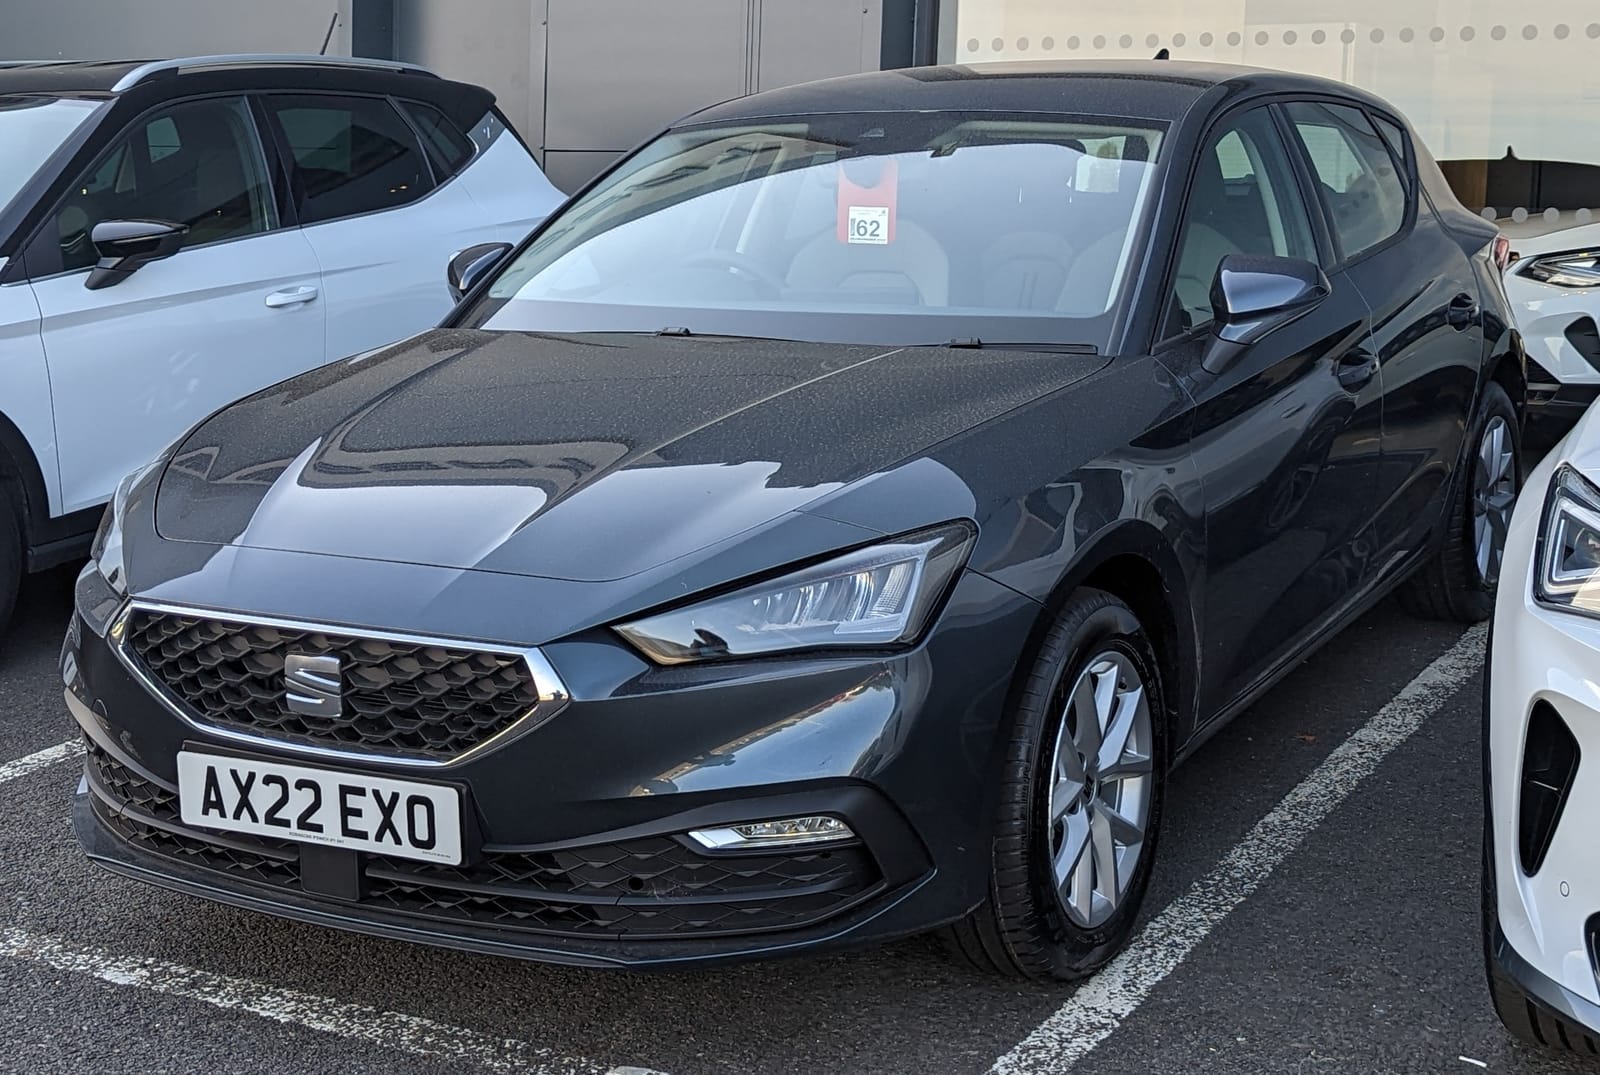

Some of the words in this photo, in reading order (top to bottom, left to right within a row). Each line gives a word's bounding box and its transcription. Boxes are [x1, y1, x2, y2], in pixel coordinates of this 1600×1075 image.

[856, 219, 880, 237] 62
[202, 765, 324, 833] AX22
[338, 784, 436, 850] EXO
